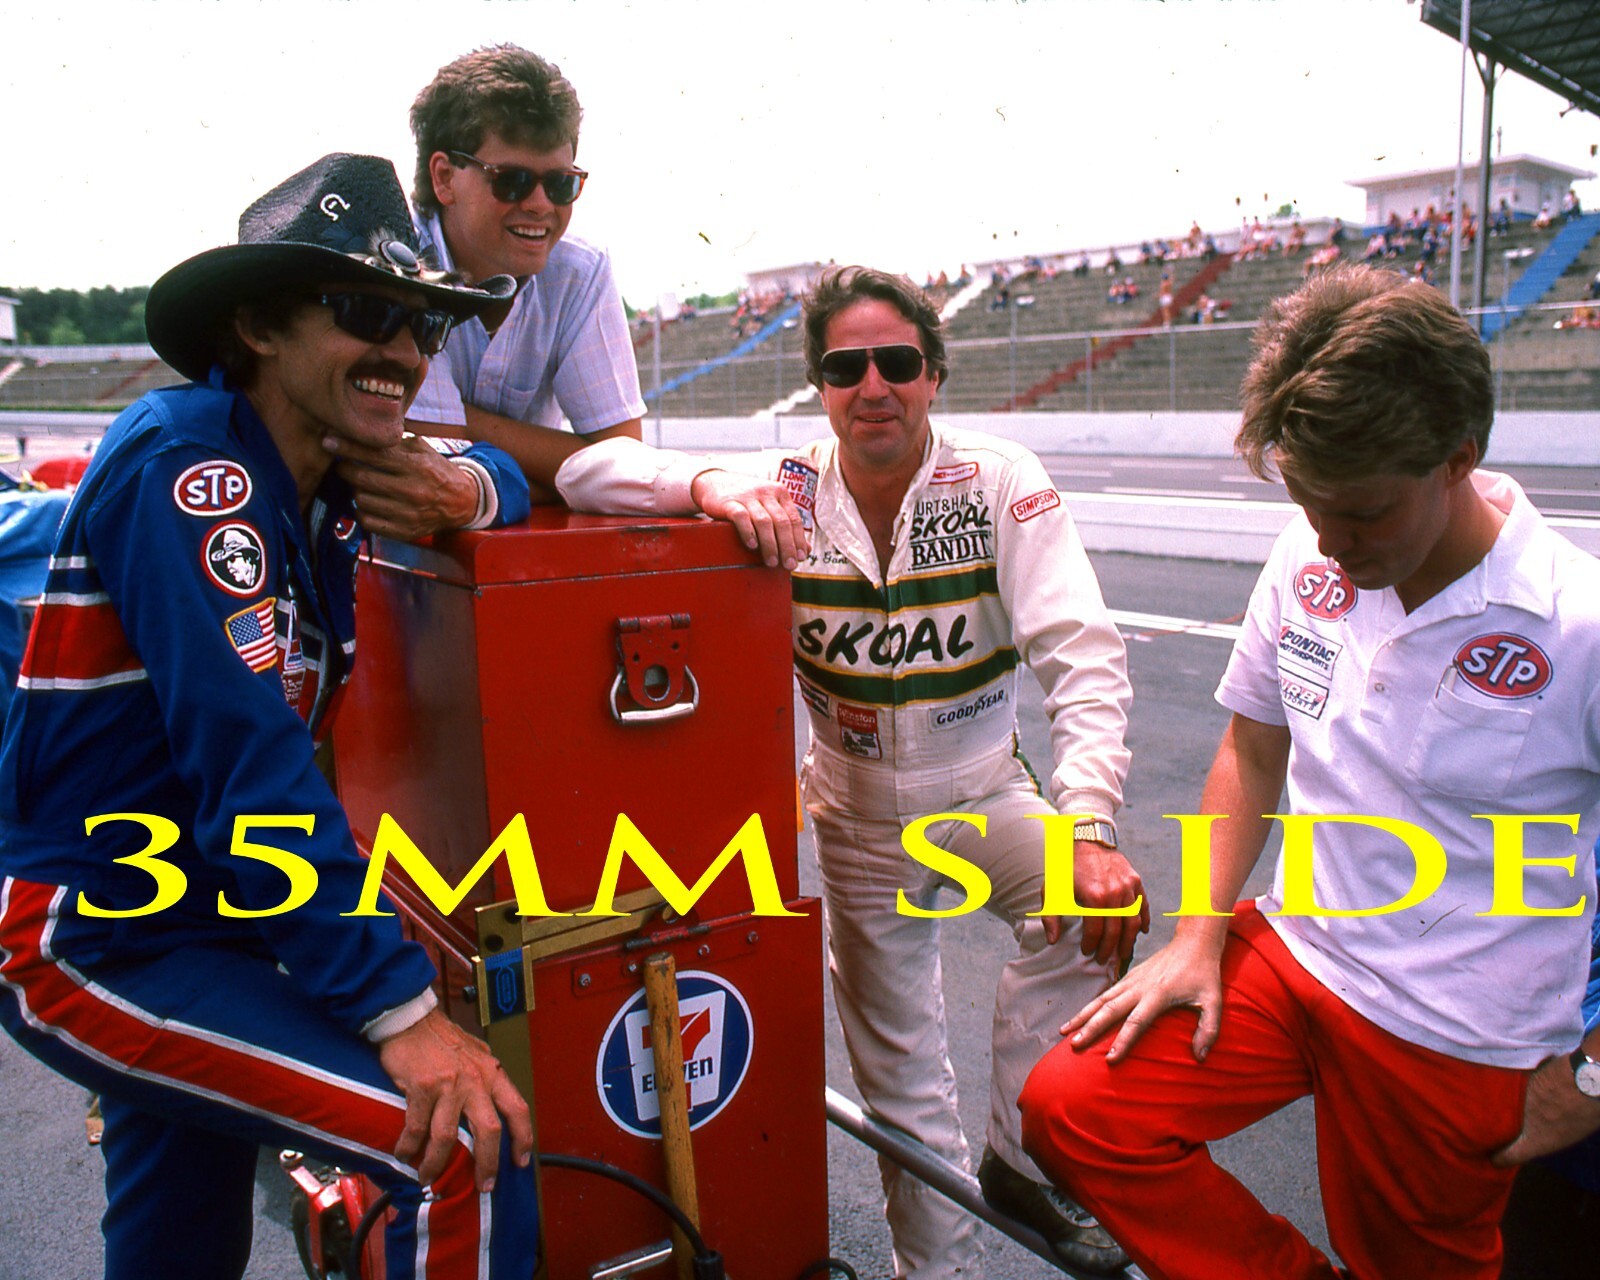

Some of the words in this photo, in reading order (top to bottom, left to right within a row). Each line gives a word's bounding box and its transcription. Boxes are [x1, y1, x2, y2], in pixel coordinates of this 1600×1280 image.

[186, 467, 244, 507] STP
[782, 480, 804, 493] IVE
[784, 470, 806, 483] LONG
[910, 503, 992, 540] SKOAL
[1016, 492, 1055, 516] SIMPSON
[911, 534, 989, 567] BANDIT
[1298, 569, 1347, 612] STP
[798, 614, 974, 666] SKOAL
[1281, 630, 1335, 662] PONTIAC
[1462, 640, 1539, 688] STP
[936, 689, 1004, 725] GOODYEAR
